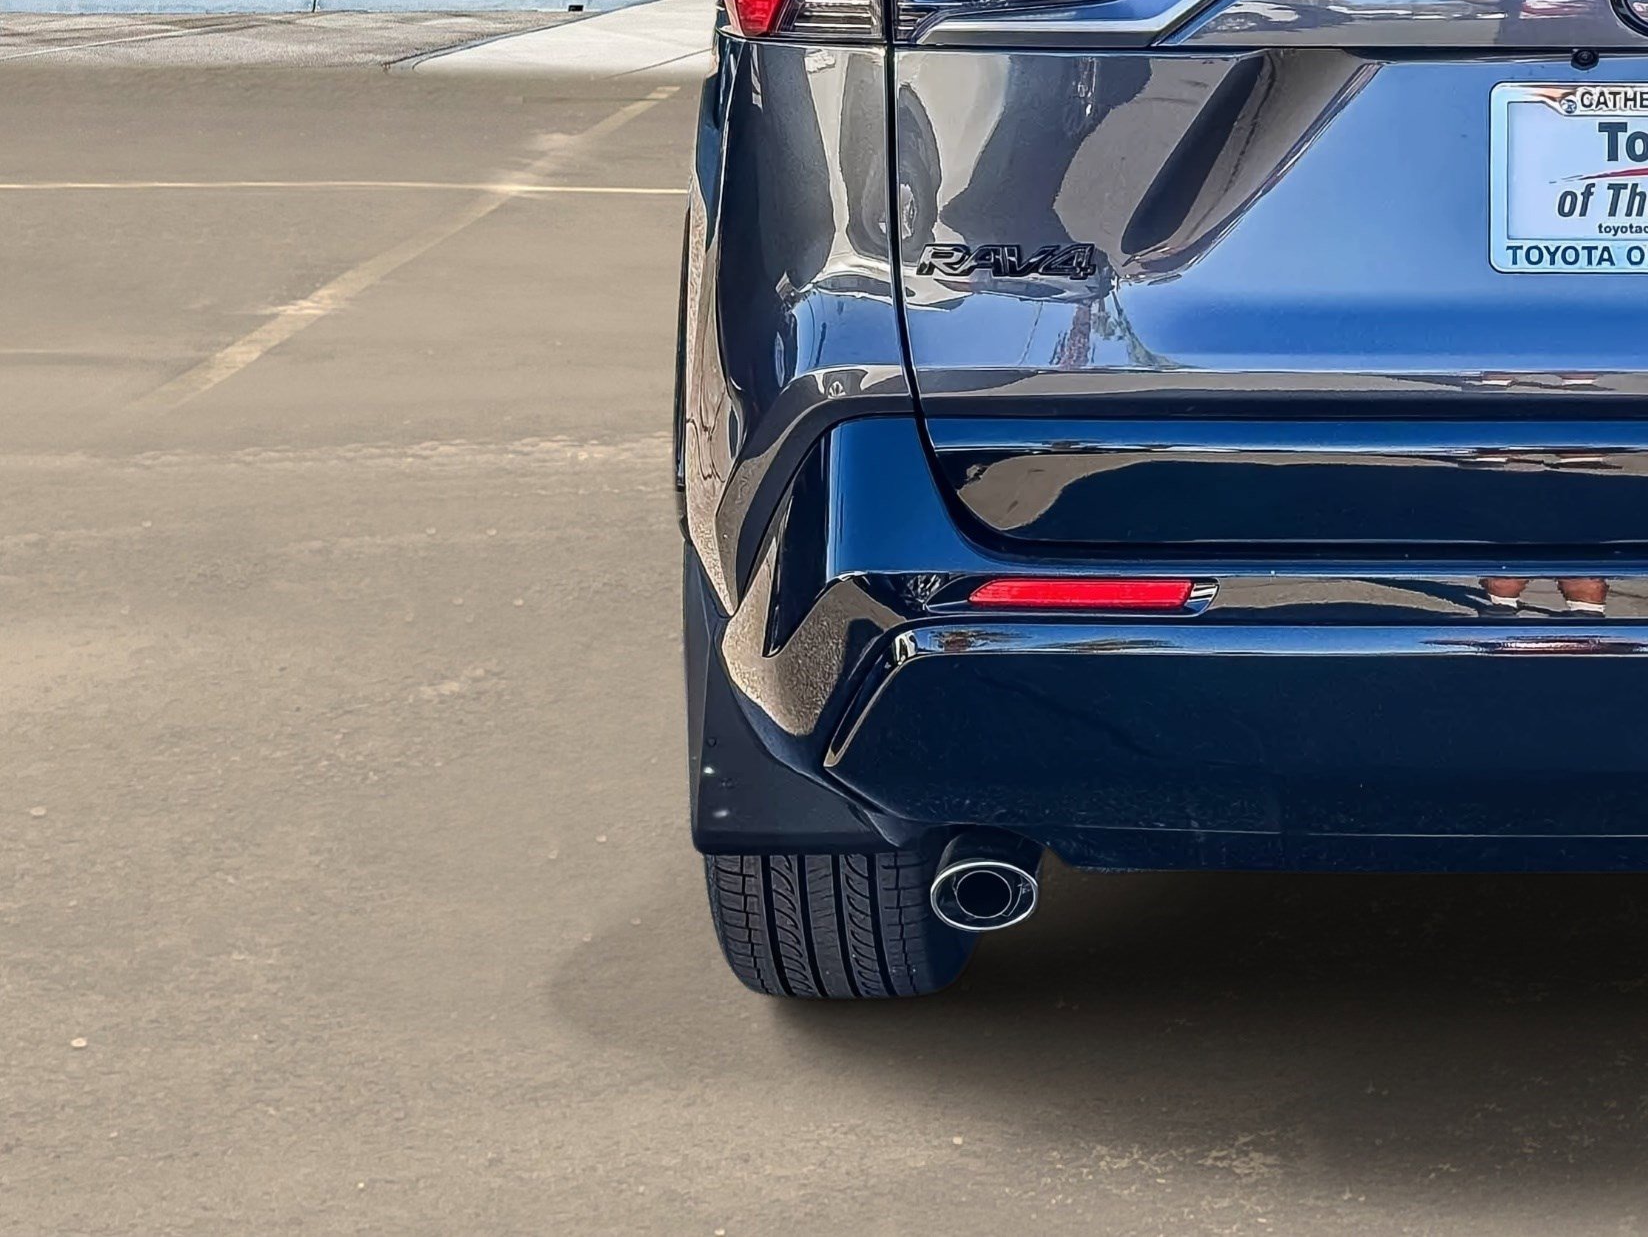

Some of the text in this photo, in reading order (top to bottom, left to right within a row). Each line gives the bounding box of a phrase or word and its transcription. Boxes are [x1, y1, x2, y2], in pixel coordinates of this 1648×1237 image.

[1557, 183, 1594, 218] of
[916, 243, 1097, 280] RAV4
[1506, 245, 1616, 268] TOYOTA
